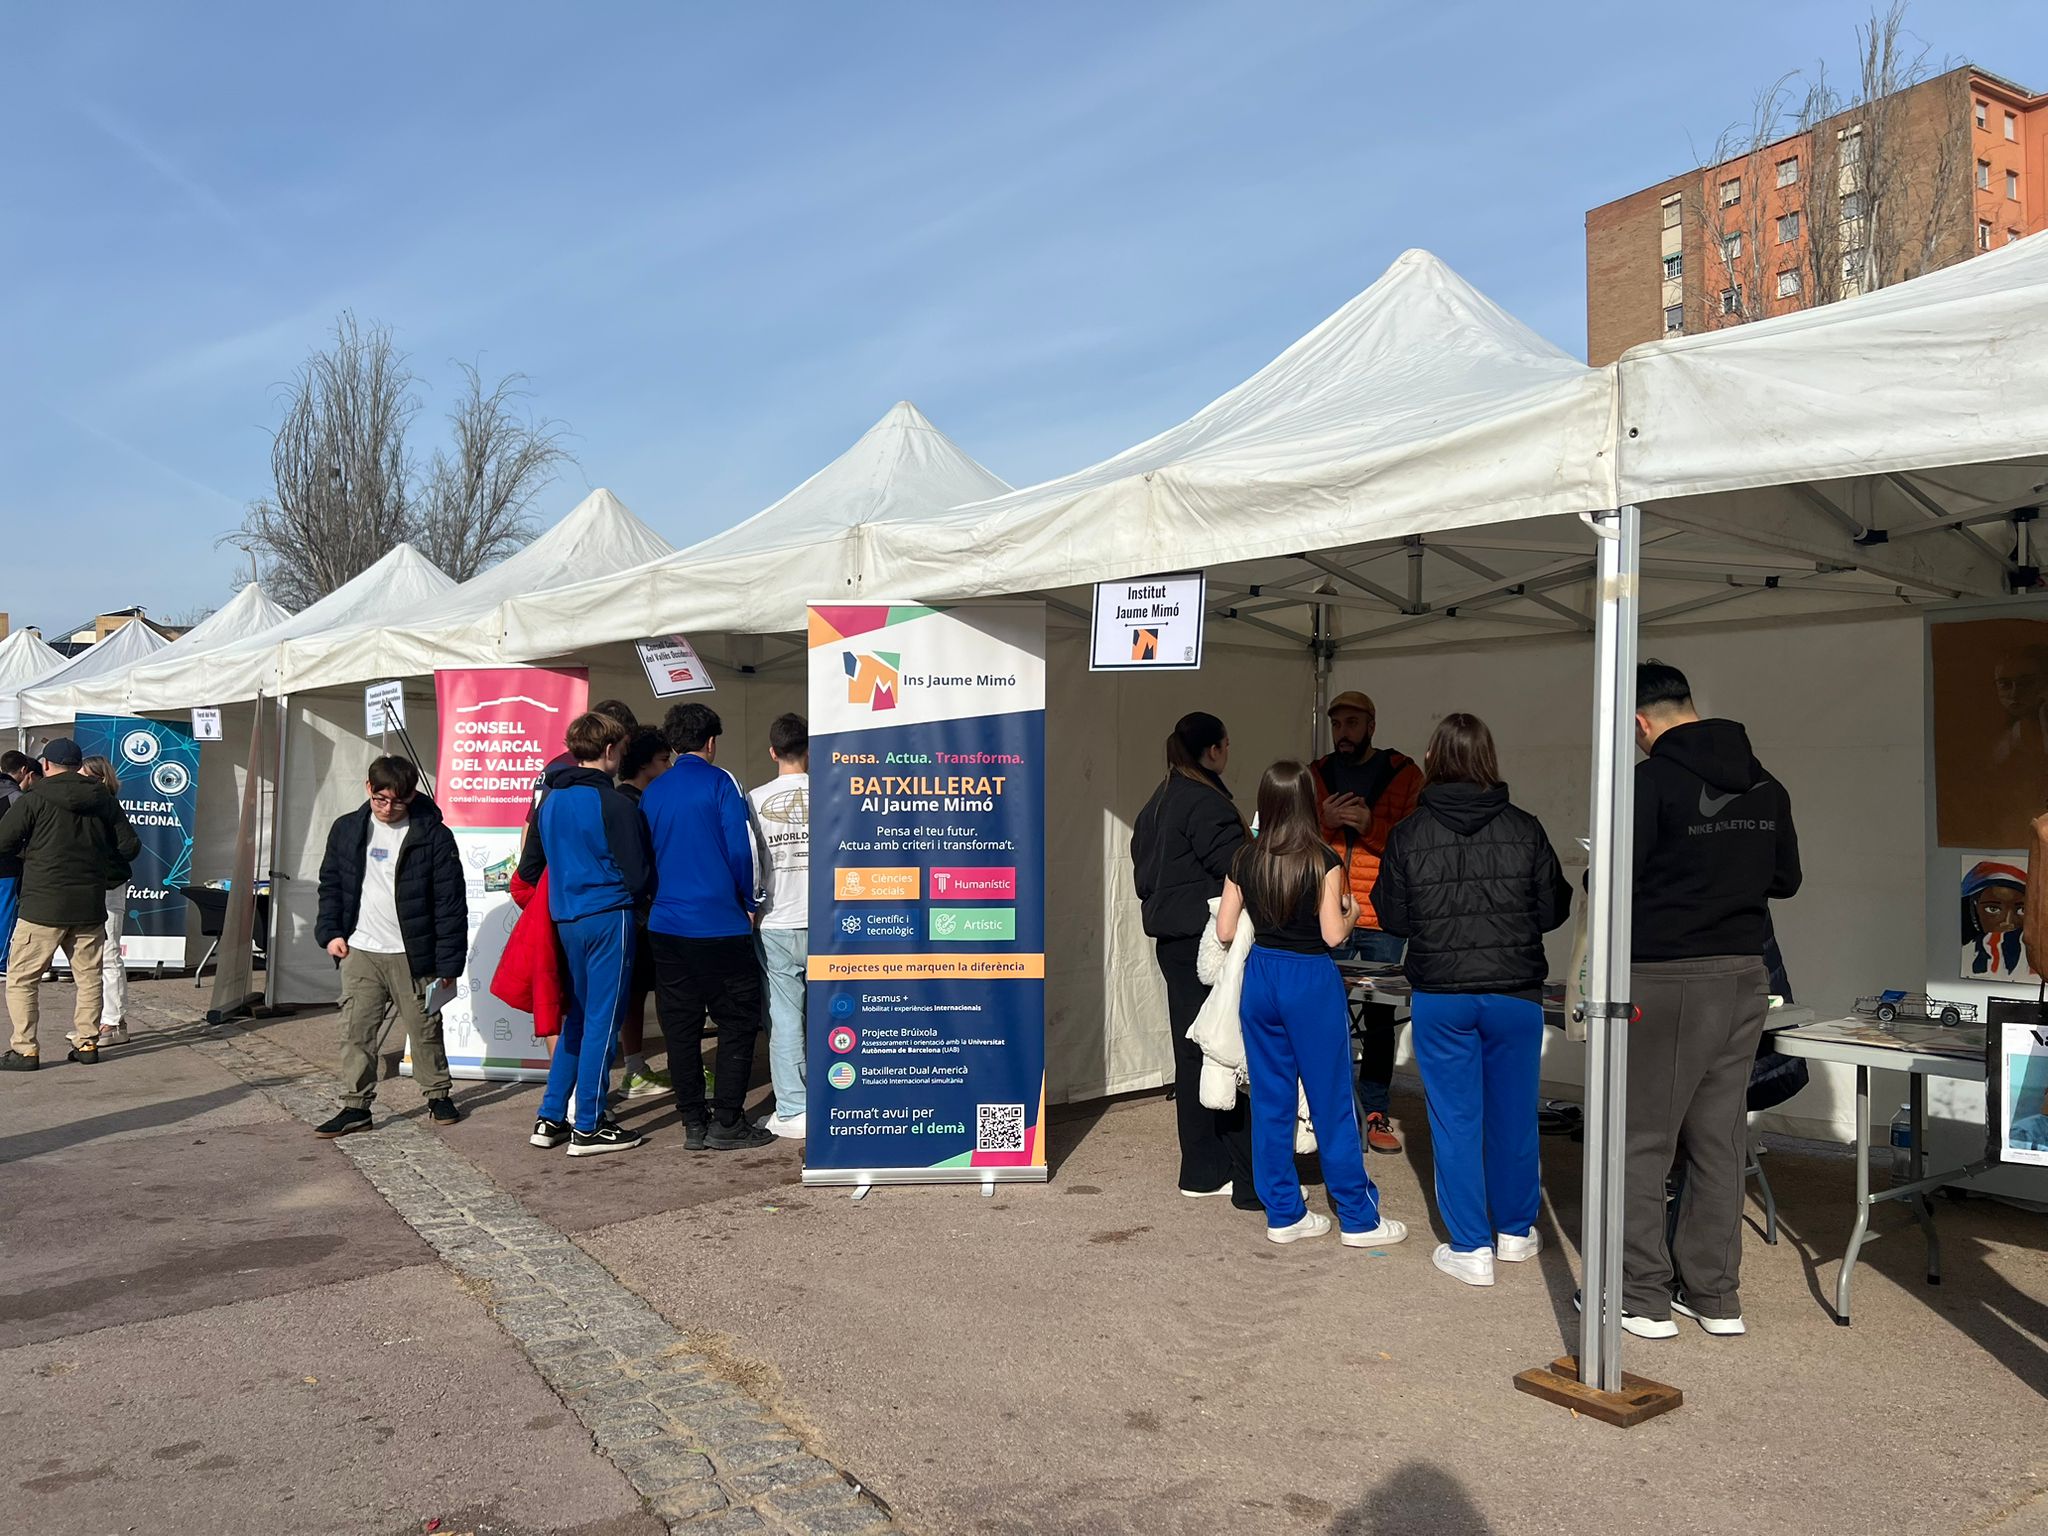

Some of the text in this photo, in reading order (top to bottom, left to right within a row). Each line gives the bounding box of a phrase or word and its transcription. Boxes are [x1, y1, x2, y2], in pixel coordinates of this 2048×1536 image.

[1127, 585, 1166, 600] Institut
[1115, 602, 1179, 619] Jaume Mimó
[903, 674, 1016, 688] Ins Jaume Mimó
[454, 721, 526, 735] CONSELL
[452, 740, 542, 753] COMARCAL
[451, 755, 544, 772] DEL VALLÈS
[832, 751, 1024, 764] Pensa. Actua. Transforma.
[850, 776, 1006, 795] BATXILLERAT
[861, 797, 993, 815] Al Jaume Mimó
[876, 826, 978, 836] Pensa el teu futur.
[1688, 823, 1713, 836] NIKE
[838, 840, 871, 850] Actua
[874, 839, 899, 850] amb
[902, 840, 935, 850] criteri
[937, 840, 941, 850] i
[871, 873, 913, 883] Ciències
[954, 879, 1011, 889] Humanístic
[126, 884, 169, 899] futur
[871, 886, 905, 896] socials
[867, 914, 909, 924] Científic i
[963, 919, 1003, 930] Artístic
[867, 926, 914, 937] tecnològic
[829, 962, 1025, 975] Projectes que marquen la diferència
[862, 994, 901, 1003] Erasmus
[894, 1004, 933, 1013] experiències
[862, 1028, 938, 1039] Projecte Brúixola
[861, 1065, 968, 1076] Batxillerat Dual Americà
[830, 1107, 934, 1121] Forma't avui per
[830, 1122, 965, 1136] transformar el demà
